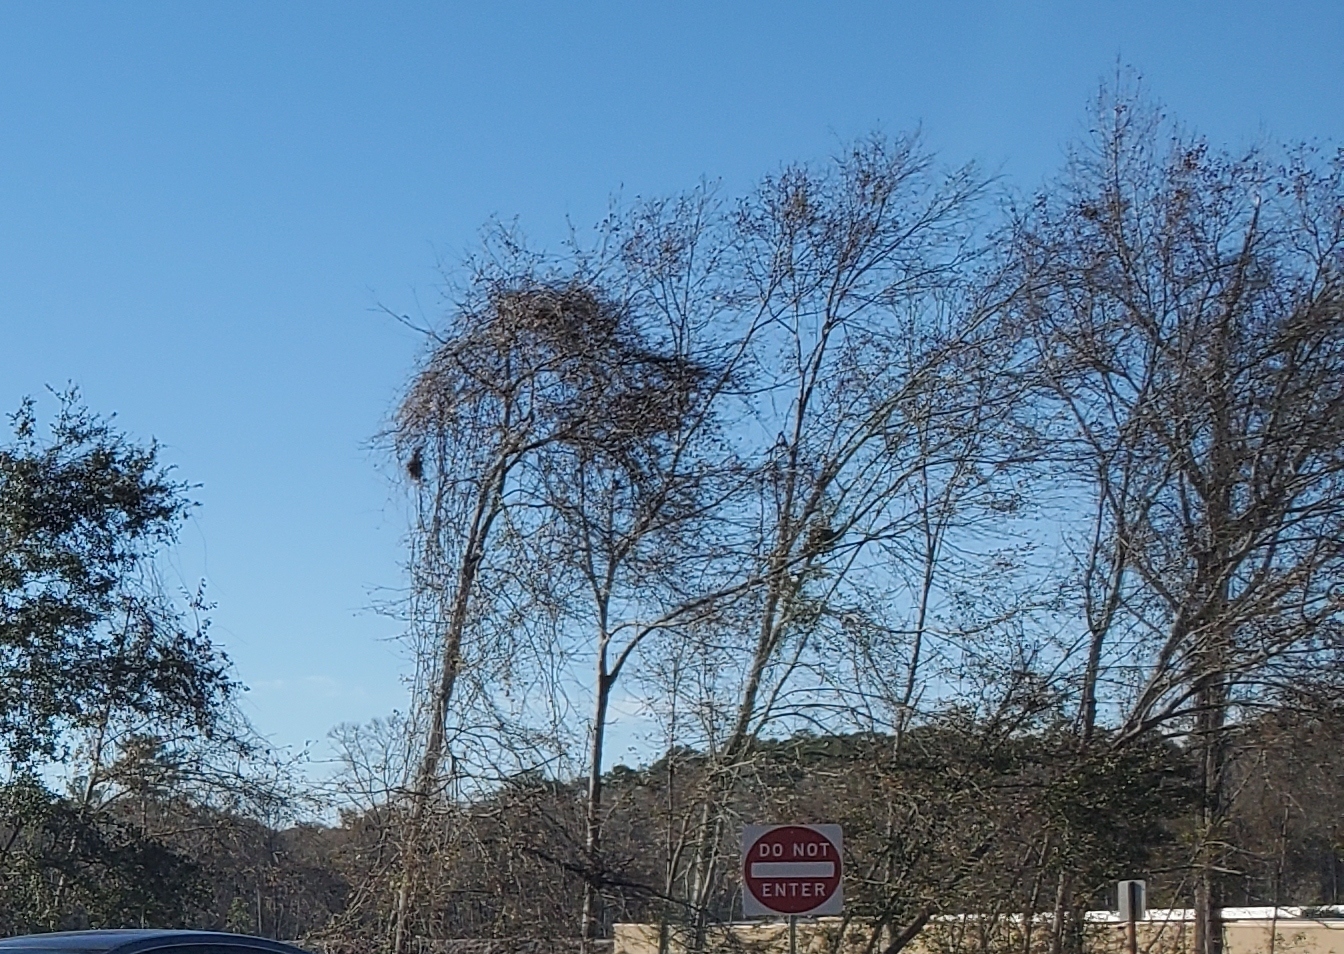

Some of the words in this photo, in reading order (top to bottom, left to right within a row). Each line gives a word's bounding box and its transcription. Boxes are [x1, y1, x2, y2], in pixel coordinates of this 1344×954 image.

[759, 843, 783, 857] DO
[793, 842, 830, 857] NOT
[762, 882, 826, 897] ENTER
